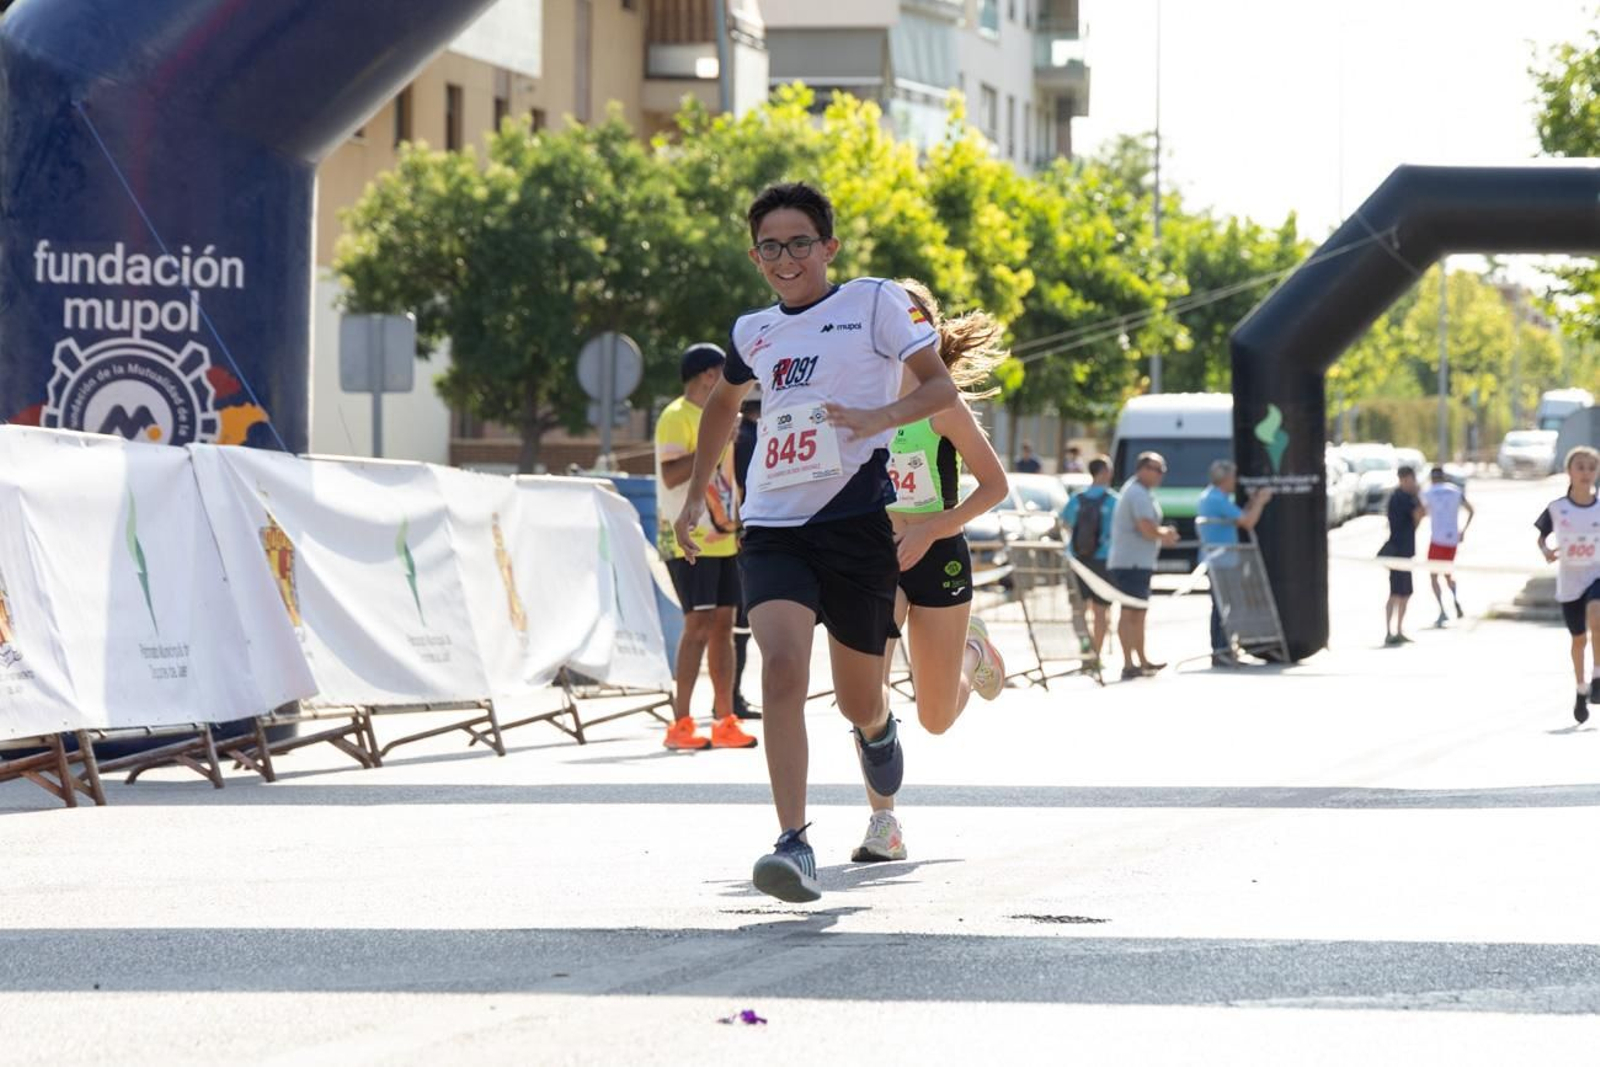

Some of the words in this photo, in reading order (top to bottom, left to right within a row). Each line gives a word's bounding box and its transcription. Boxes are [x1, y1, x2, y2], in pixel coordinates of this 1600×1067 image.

[34, 239, 244, 288] fundación
[63, 289, 200, 338] mupol
[765, 428, 817, 469] 845
